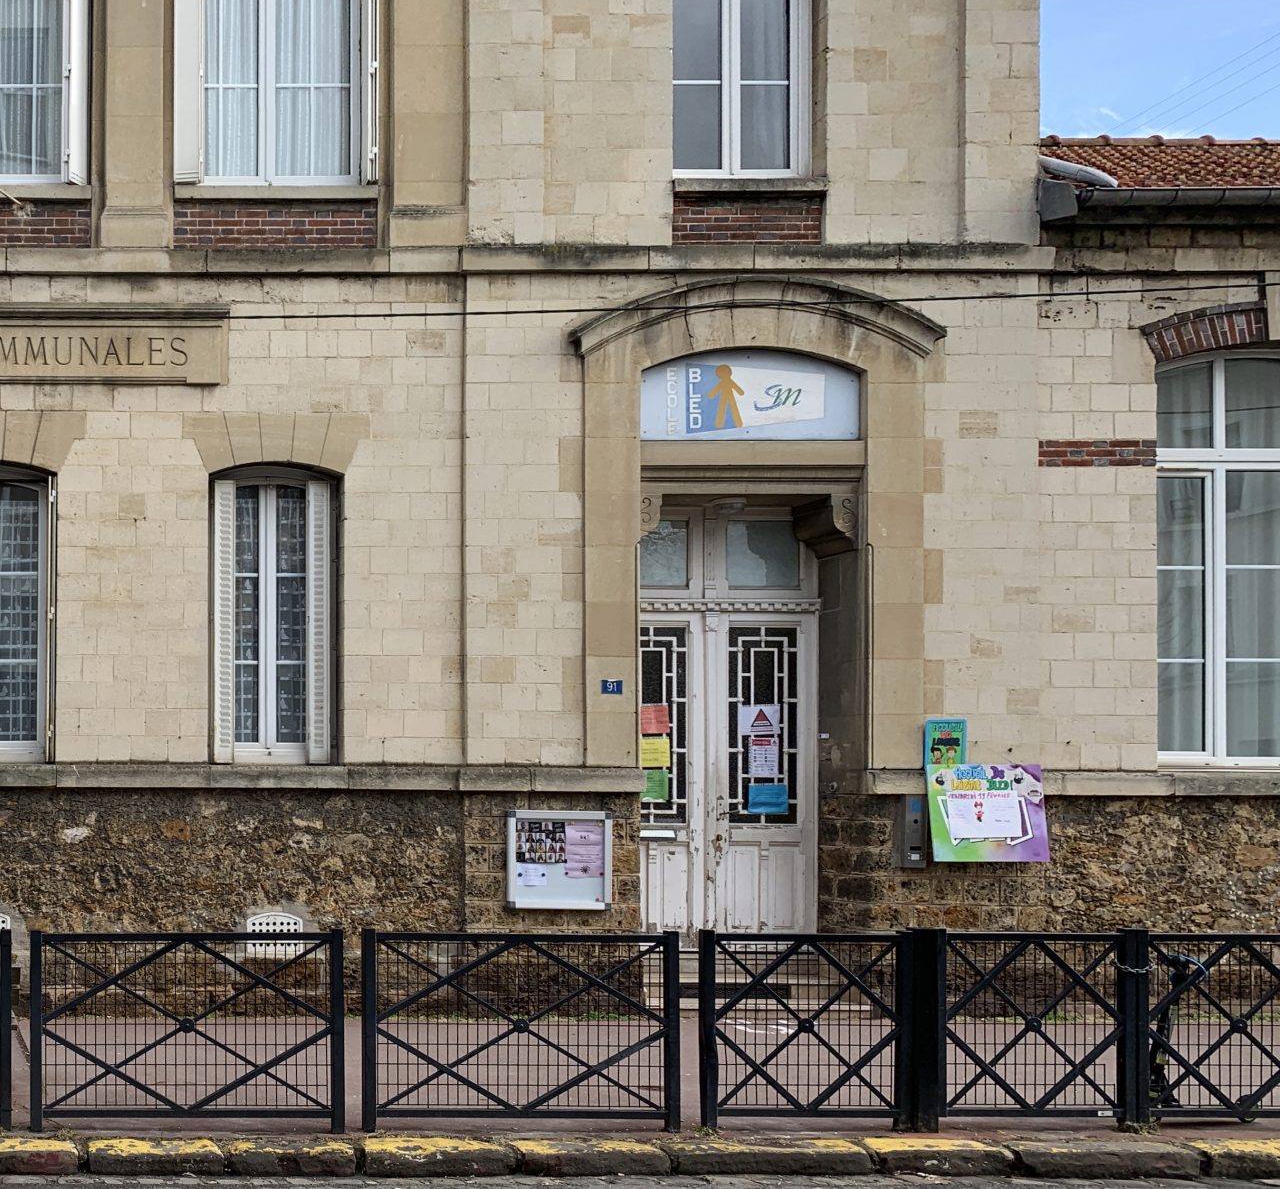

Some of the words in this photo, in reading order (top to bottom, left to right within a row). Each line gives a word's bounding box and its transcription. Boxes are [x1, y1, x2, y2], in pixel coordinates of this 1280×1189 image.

[665, 367, 680, 435] ECOLE
[688, 367, 703, 429] BLED
[606, 681, 617, 692] 91
